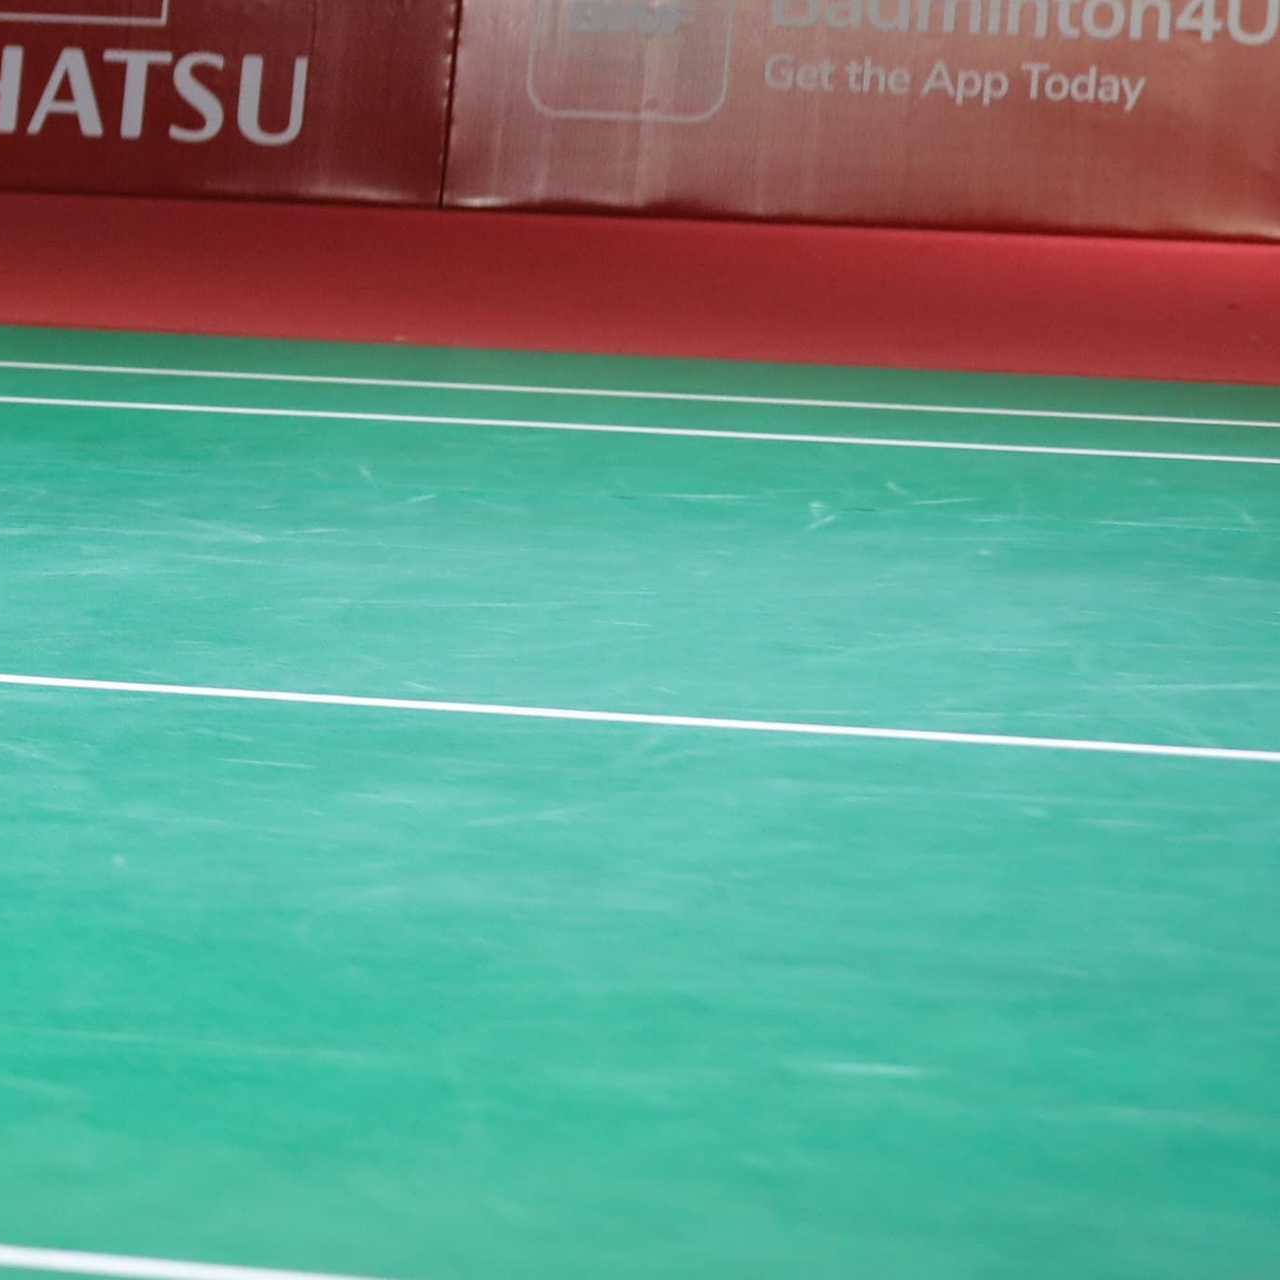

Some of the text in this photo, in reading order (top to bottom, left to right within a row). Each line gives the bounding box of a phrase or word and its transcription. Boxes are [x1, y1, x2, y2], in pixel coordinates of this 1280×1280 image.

[764, 53, 1146, 112] Get the App Today
